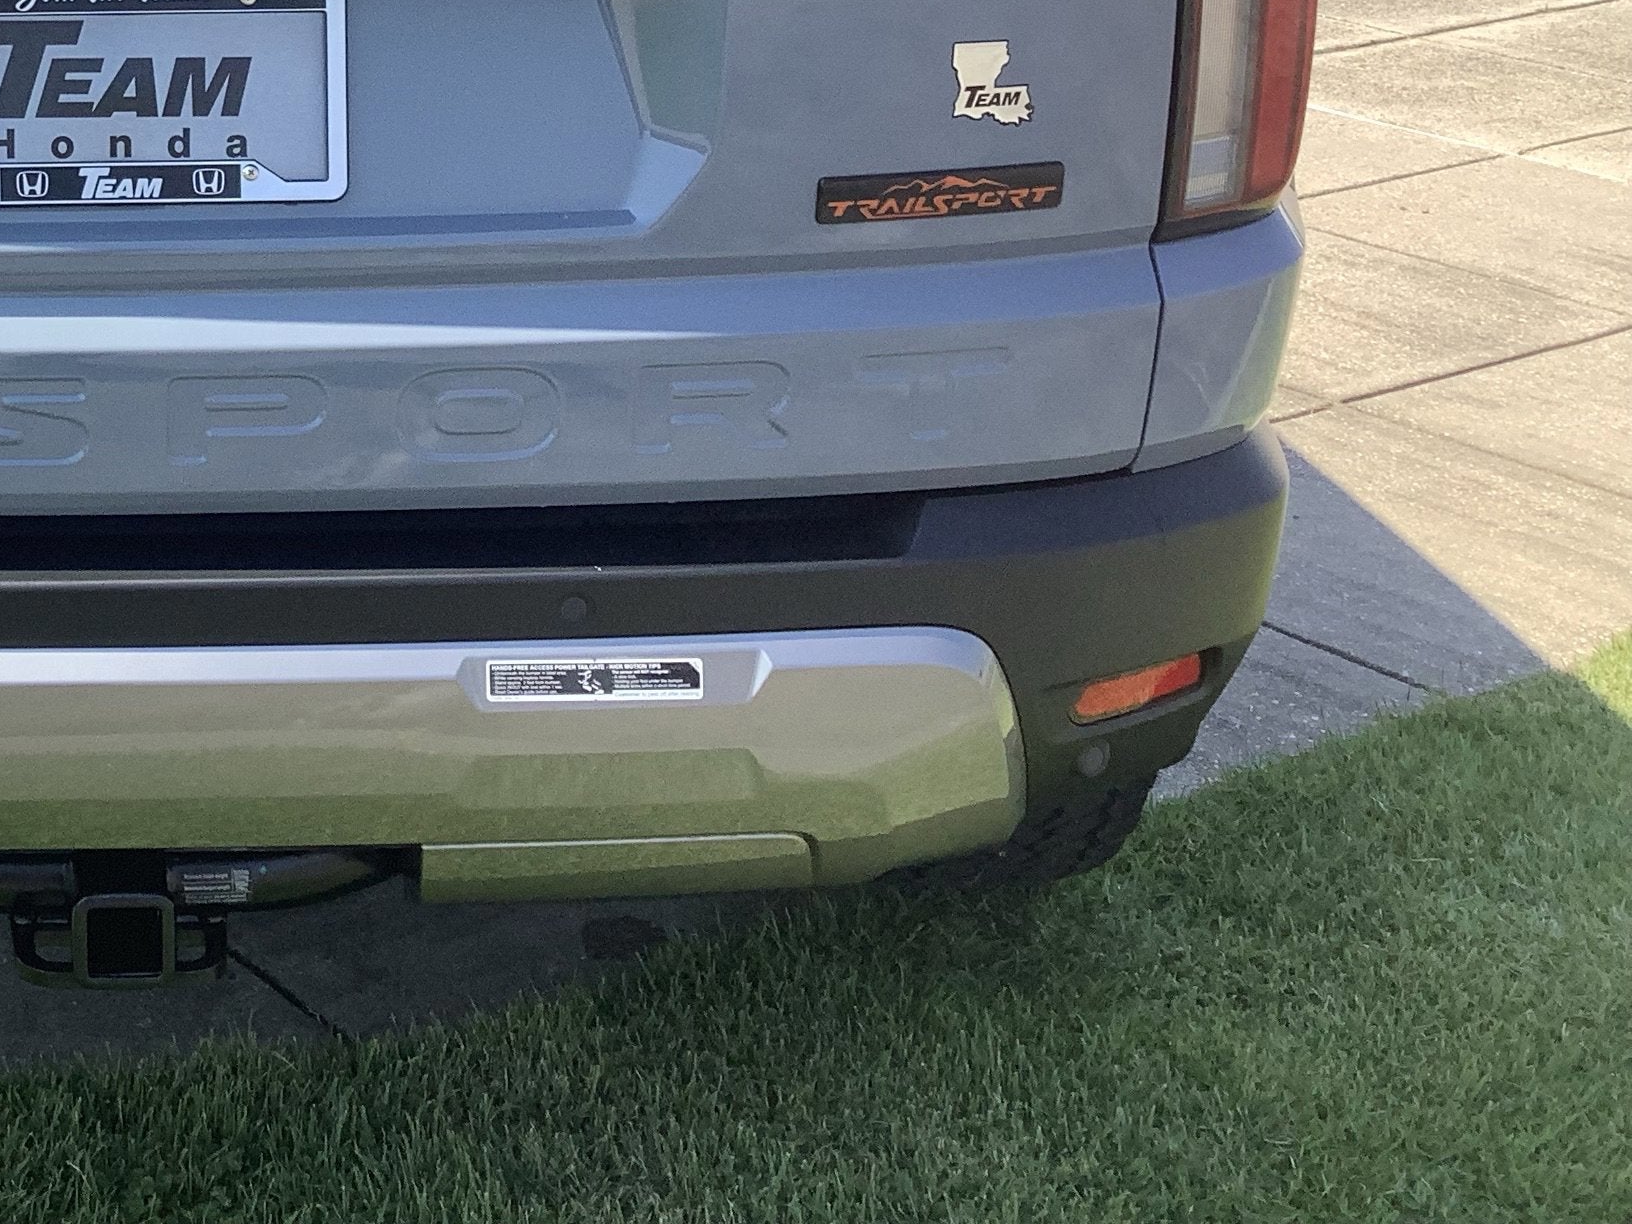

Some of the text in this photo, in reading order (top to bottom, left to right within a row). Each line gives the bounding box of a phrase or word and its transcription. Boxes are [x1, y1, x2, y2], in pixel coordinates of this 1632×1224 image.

[964, 85, 1021, 108] TEAM
[78, 167, 163, 200] TEAM
[827, 186, 1057, 220] TRAILSPORT
